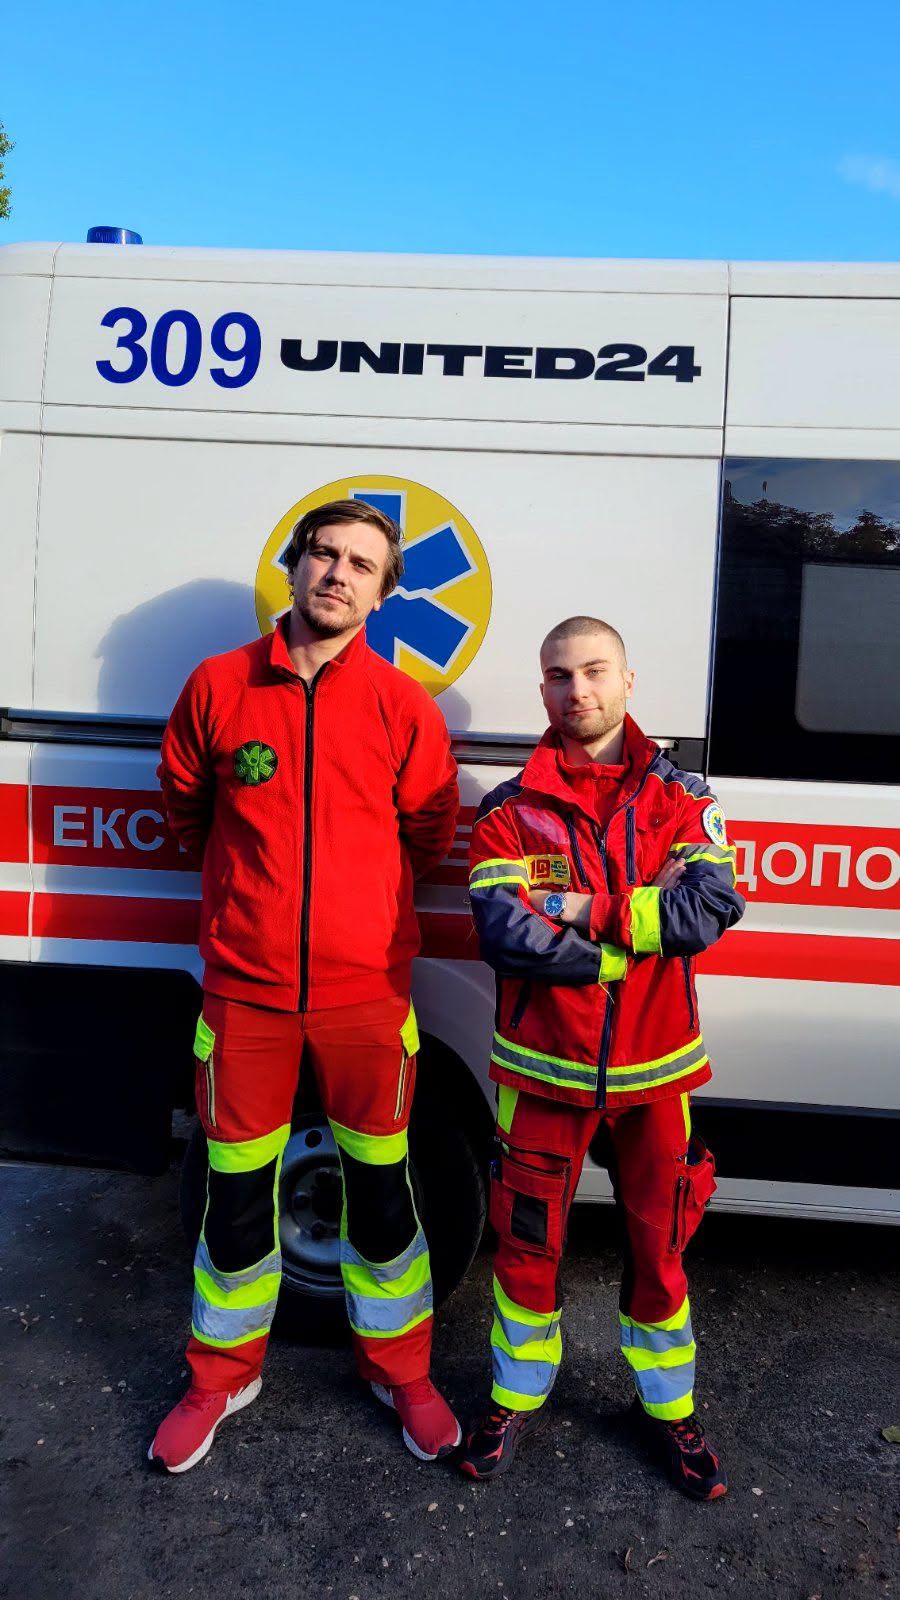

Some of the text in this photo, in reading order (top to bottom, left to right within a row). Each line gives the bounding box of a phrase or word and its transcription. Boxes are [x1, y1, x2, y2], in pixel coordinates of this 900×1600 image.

[96, 306, 262, 389] 309
[280, 338, 702, 383] UNITED24
[53, 805, 188, 853] ЕКС
